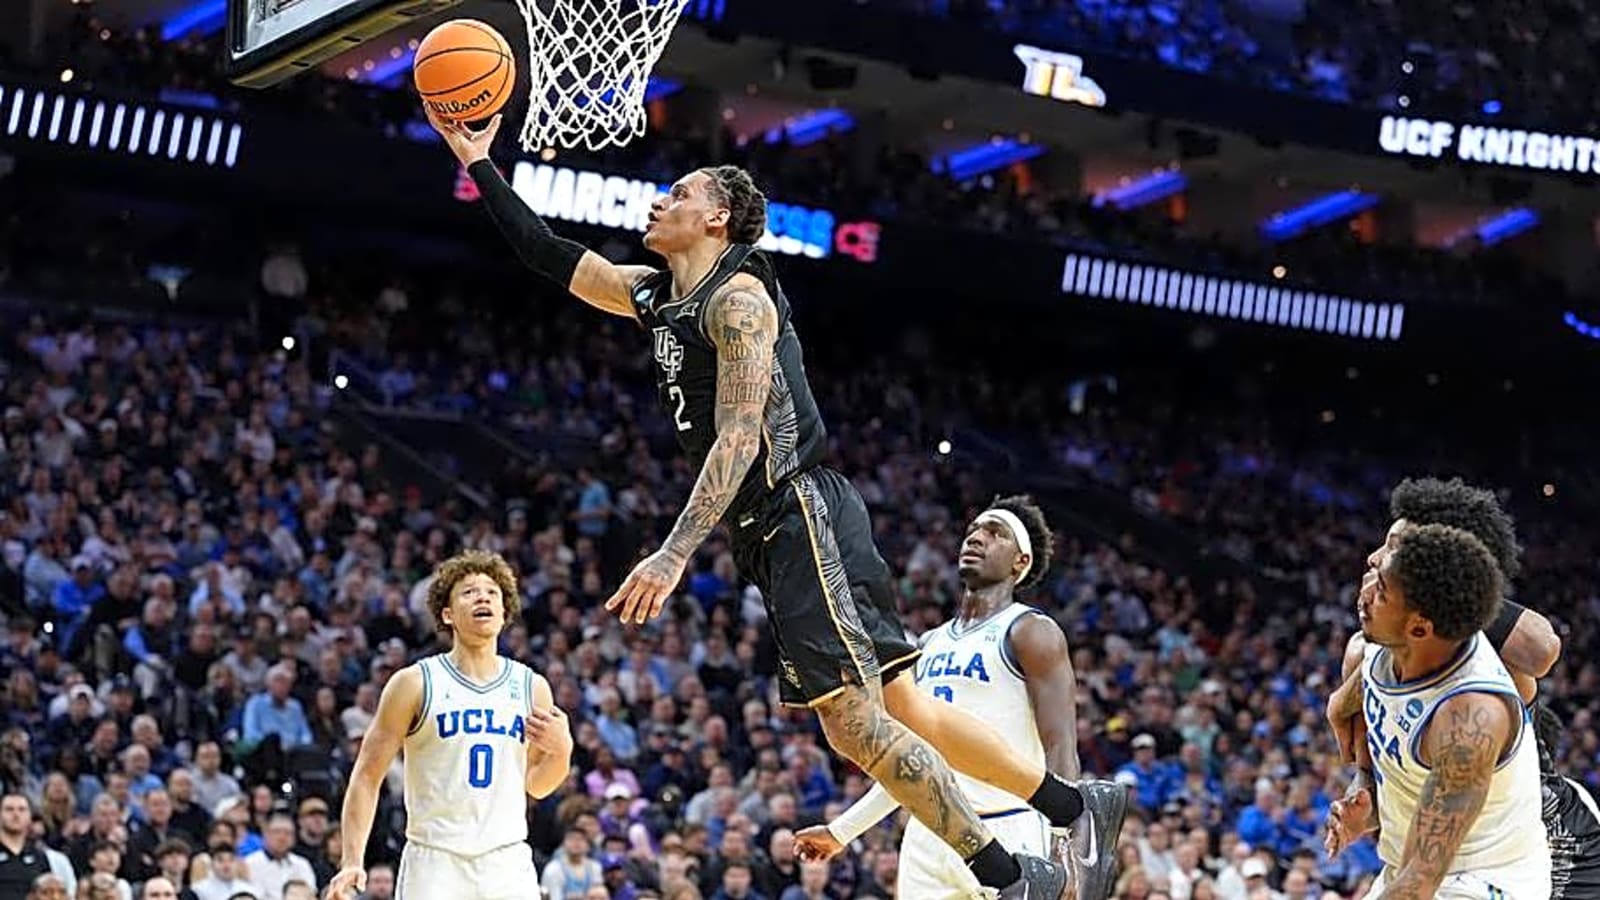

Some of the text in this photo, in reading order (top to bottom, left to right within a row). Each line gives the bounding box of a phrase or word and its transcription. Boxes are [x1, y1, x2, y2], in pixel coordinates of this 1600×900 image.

[428, 89, 491, 114] Wilson
[1379, 115, 1454, 158] UCF
[512, 161, 655, 233] MARCH
[652, 326, 684, 383] UCF
[669, 386, 693, 431] 2
[437, 708, 525, 744] UCLA
[1364, 680, 1407, 770] CLA
[468, 743, 494, 788] 0
